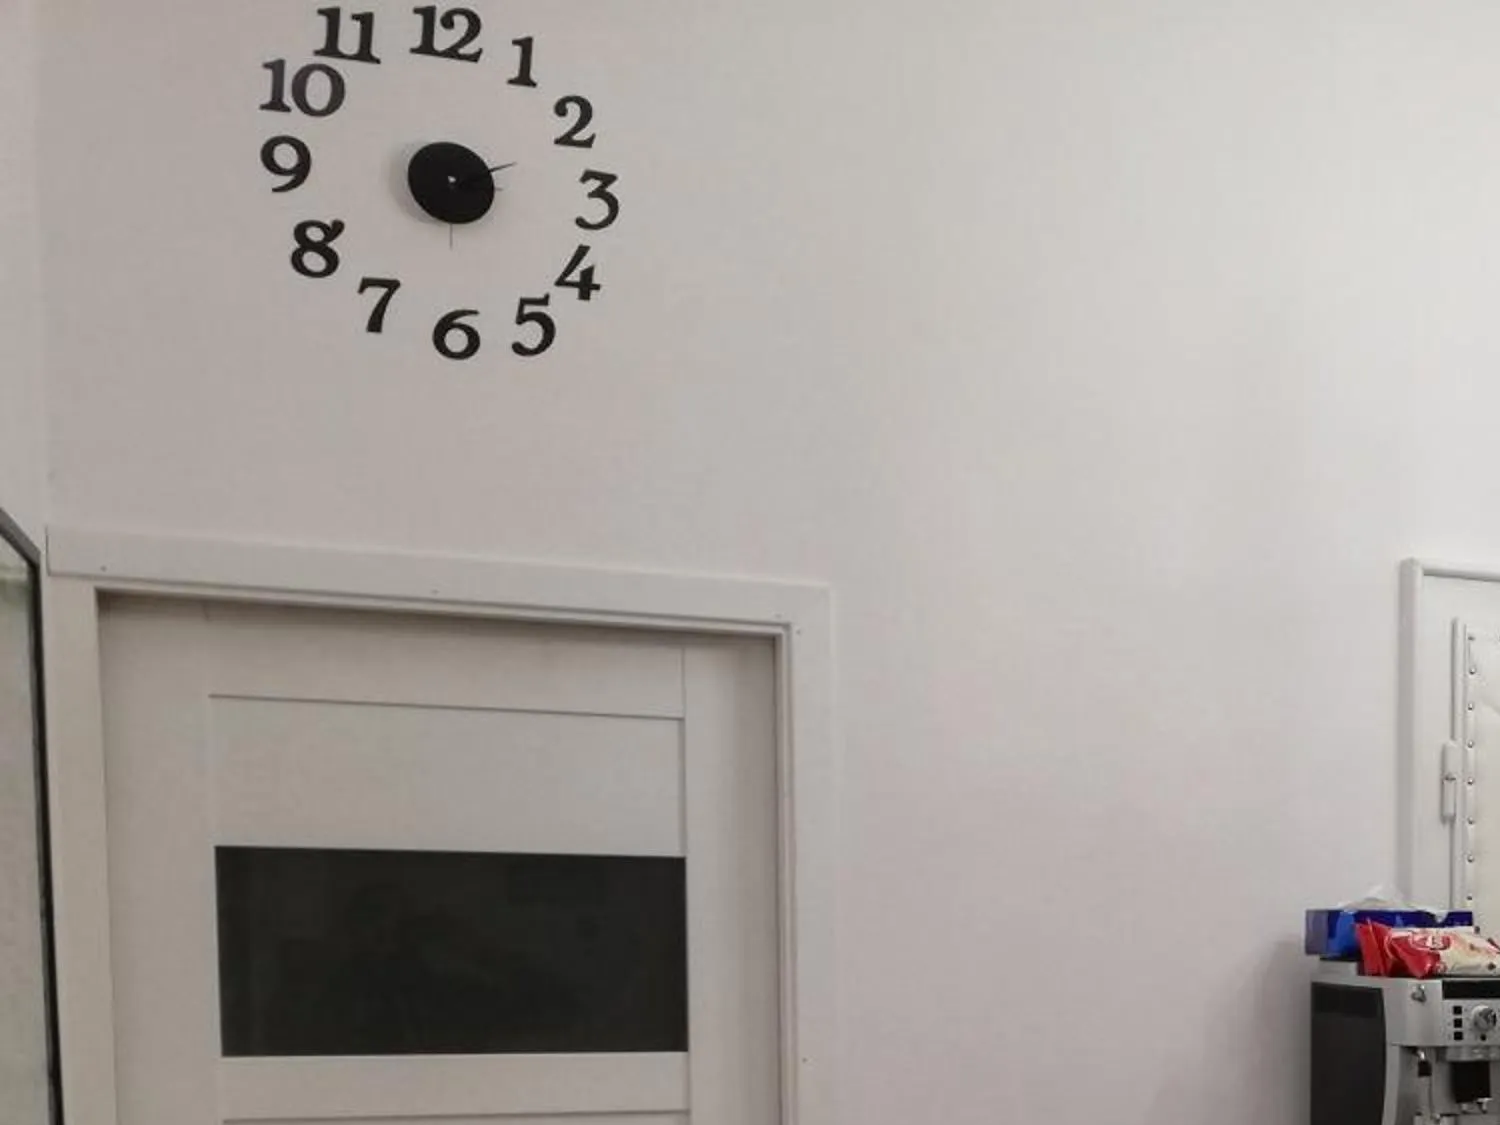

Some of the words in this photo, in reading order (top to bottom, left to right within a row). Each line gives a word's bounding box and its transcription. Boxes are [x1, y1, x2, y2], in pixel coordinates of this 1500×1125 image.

[313, 6, 381, 64] 11
[409, 5, 483, 62] 12
[507, 36, 538, 87] 1
[259, 58, 346, 117] 10
[554, 95, 596, 148] 2
[260, 135, 312, 192] 9
[574, 169, 620, 230] 3
[291, 219, 345, 278] 8
[554, 244, 601, 301] 4
[357, 277, 401, 333] 7
[511, 292, 556, 356] 5
[432, 309, 480, 360] 6
